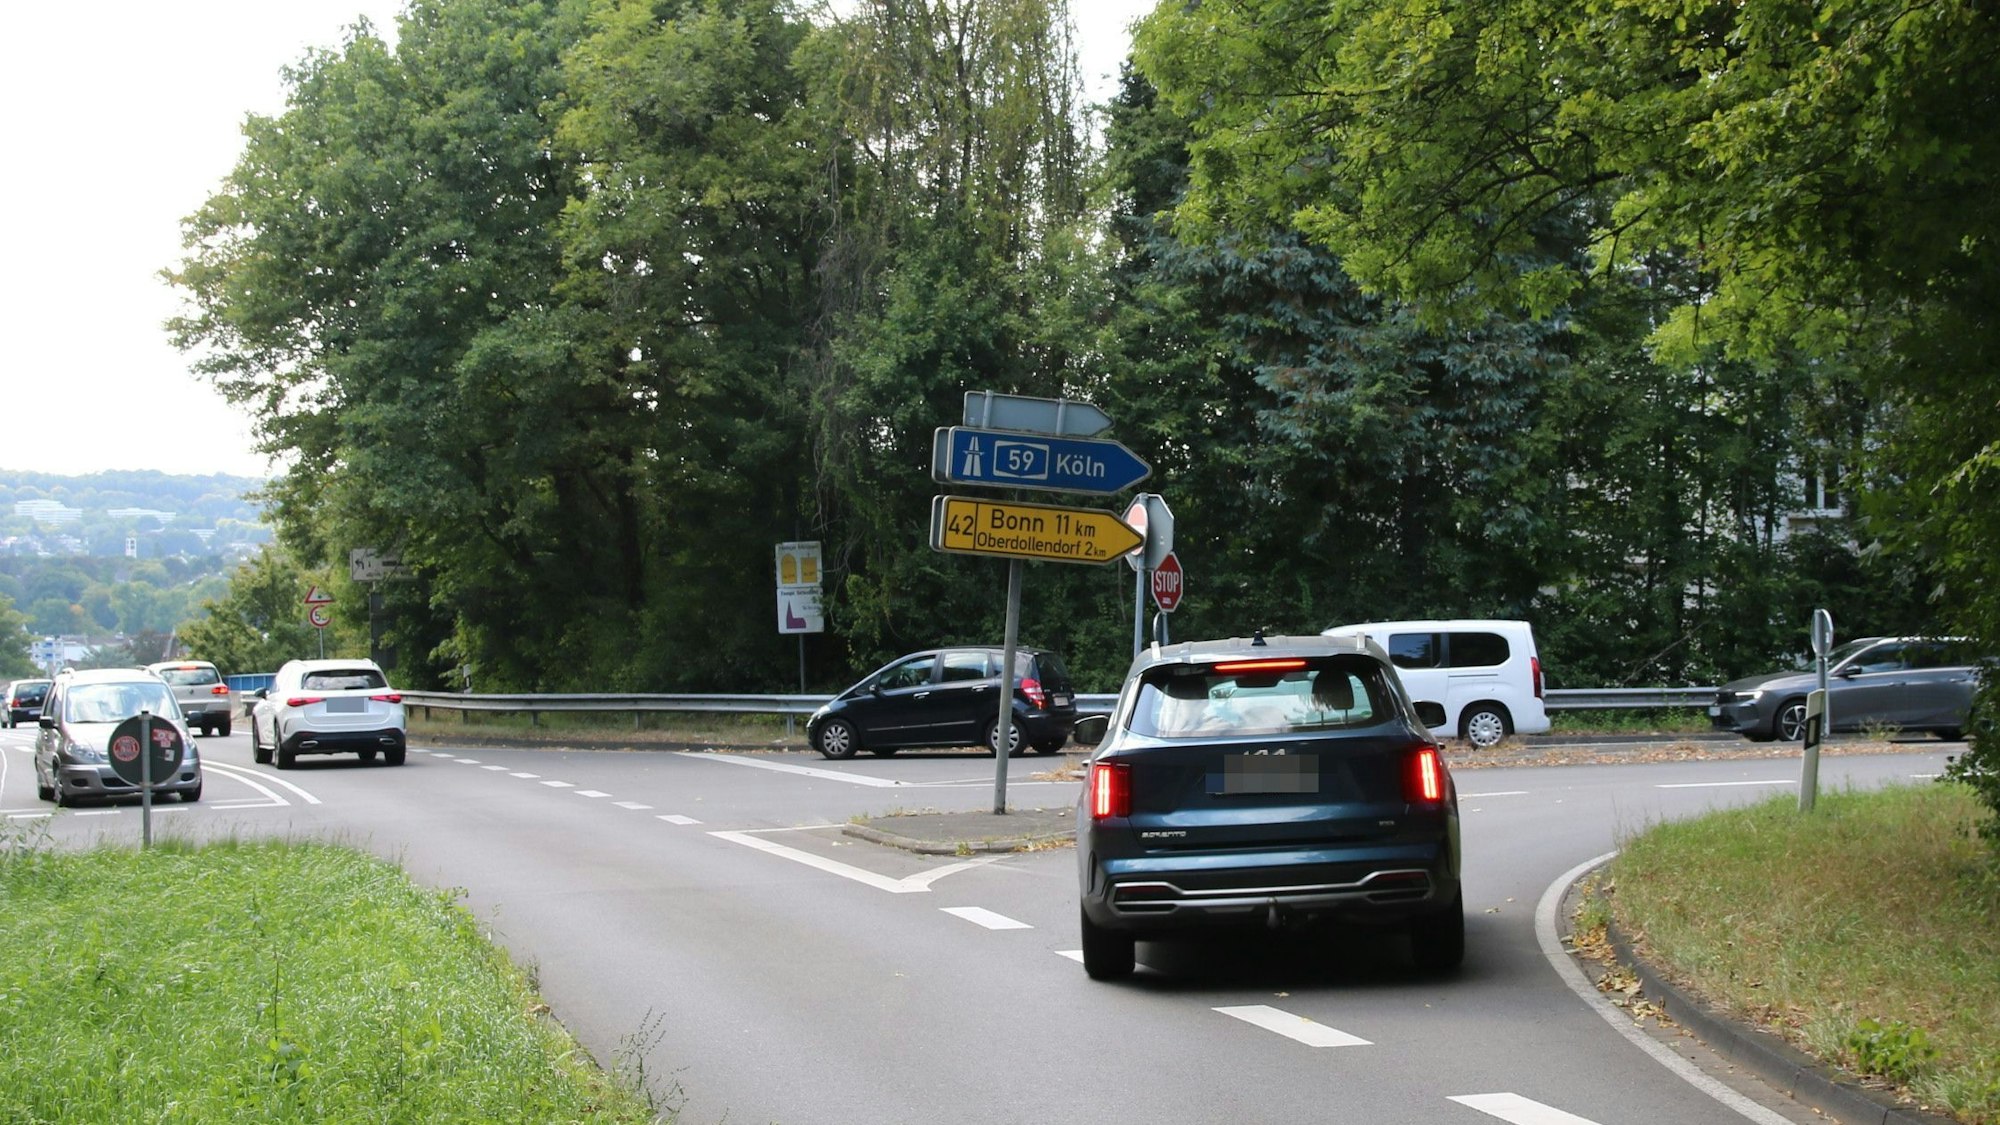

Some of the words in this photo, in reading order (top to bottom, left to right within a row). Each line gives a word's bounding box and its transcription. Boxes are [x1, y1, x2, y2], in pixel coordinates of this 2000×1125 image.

[1008, 449, 1035, 471] 59
[1056, 453, 1105, 478] Köln
[948, 515, 974, 536] 42
[991, 509, 1044, 533] Bonn
[1056, 514, 1070, 535] 11
[1075, 519, 1096, 538] km
[977, 532, 1082, 556] Oberdollendorf
[1155, 571, 1179, 593] STOP
